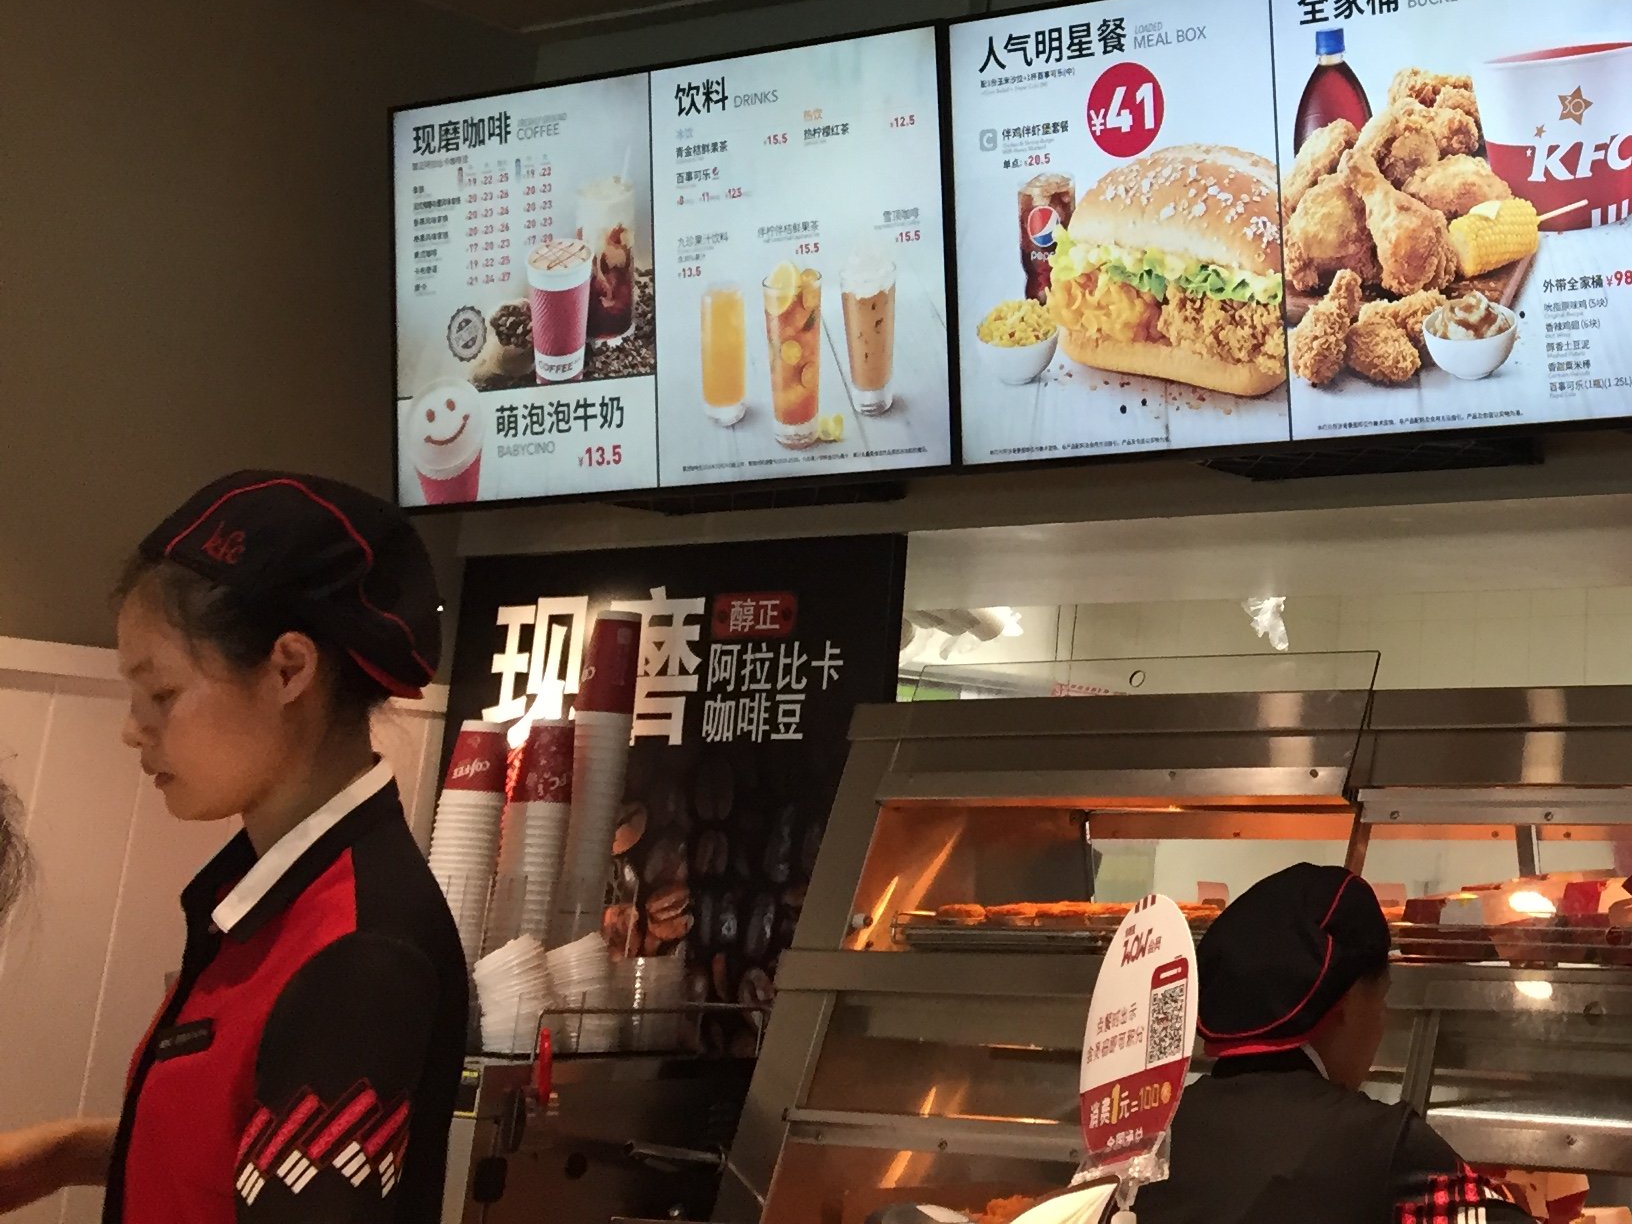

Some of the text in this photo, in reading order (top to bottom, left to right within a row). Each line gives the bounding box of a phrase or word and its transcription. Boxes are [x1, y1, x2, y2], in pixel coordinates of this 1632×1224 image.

[978, 16, 1128, 74] 人气明星餐
[1133, 25, 1207, 50] MEAL BOX
[674, 76, 779, 117] 饮料 DRINKS
[1089, 82, 1155, 136] ¥41
[412, 110, 560, 156] 现磨咖啡 COFFEE
[1002, 120, 1069, 141] 伴鸡伴虾堡套餐
[1543, 274, 1604, 294] 外带全家桶
[538, 360, 573, 373] COFFEE
[495, 394, 625, 438] 萌泡泡牛奶
[497, 441, 555, 458] BABYCINO
[578, 444, 622, 468] ¥13.5
[728, 599, 782, 633] 醇正
[706, 640, 844, 691] 阿拉比卡
[701, 693, 806, 744] 咖啡豆
